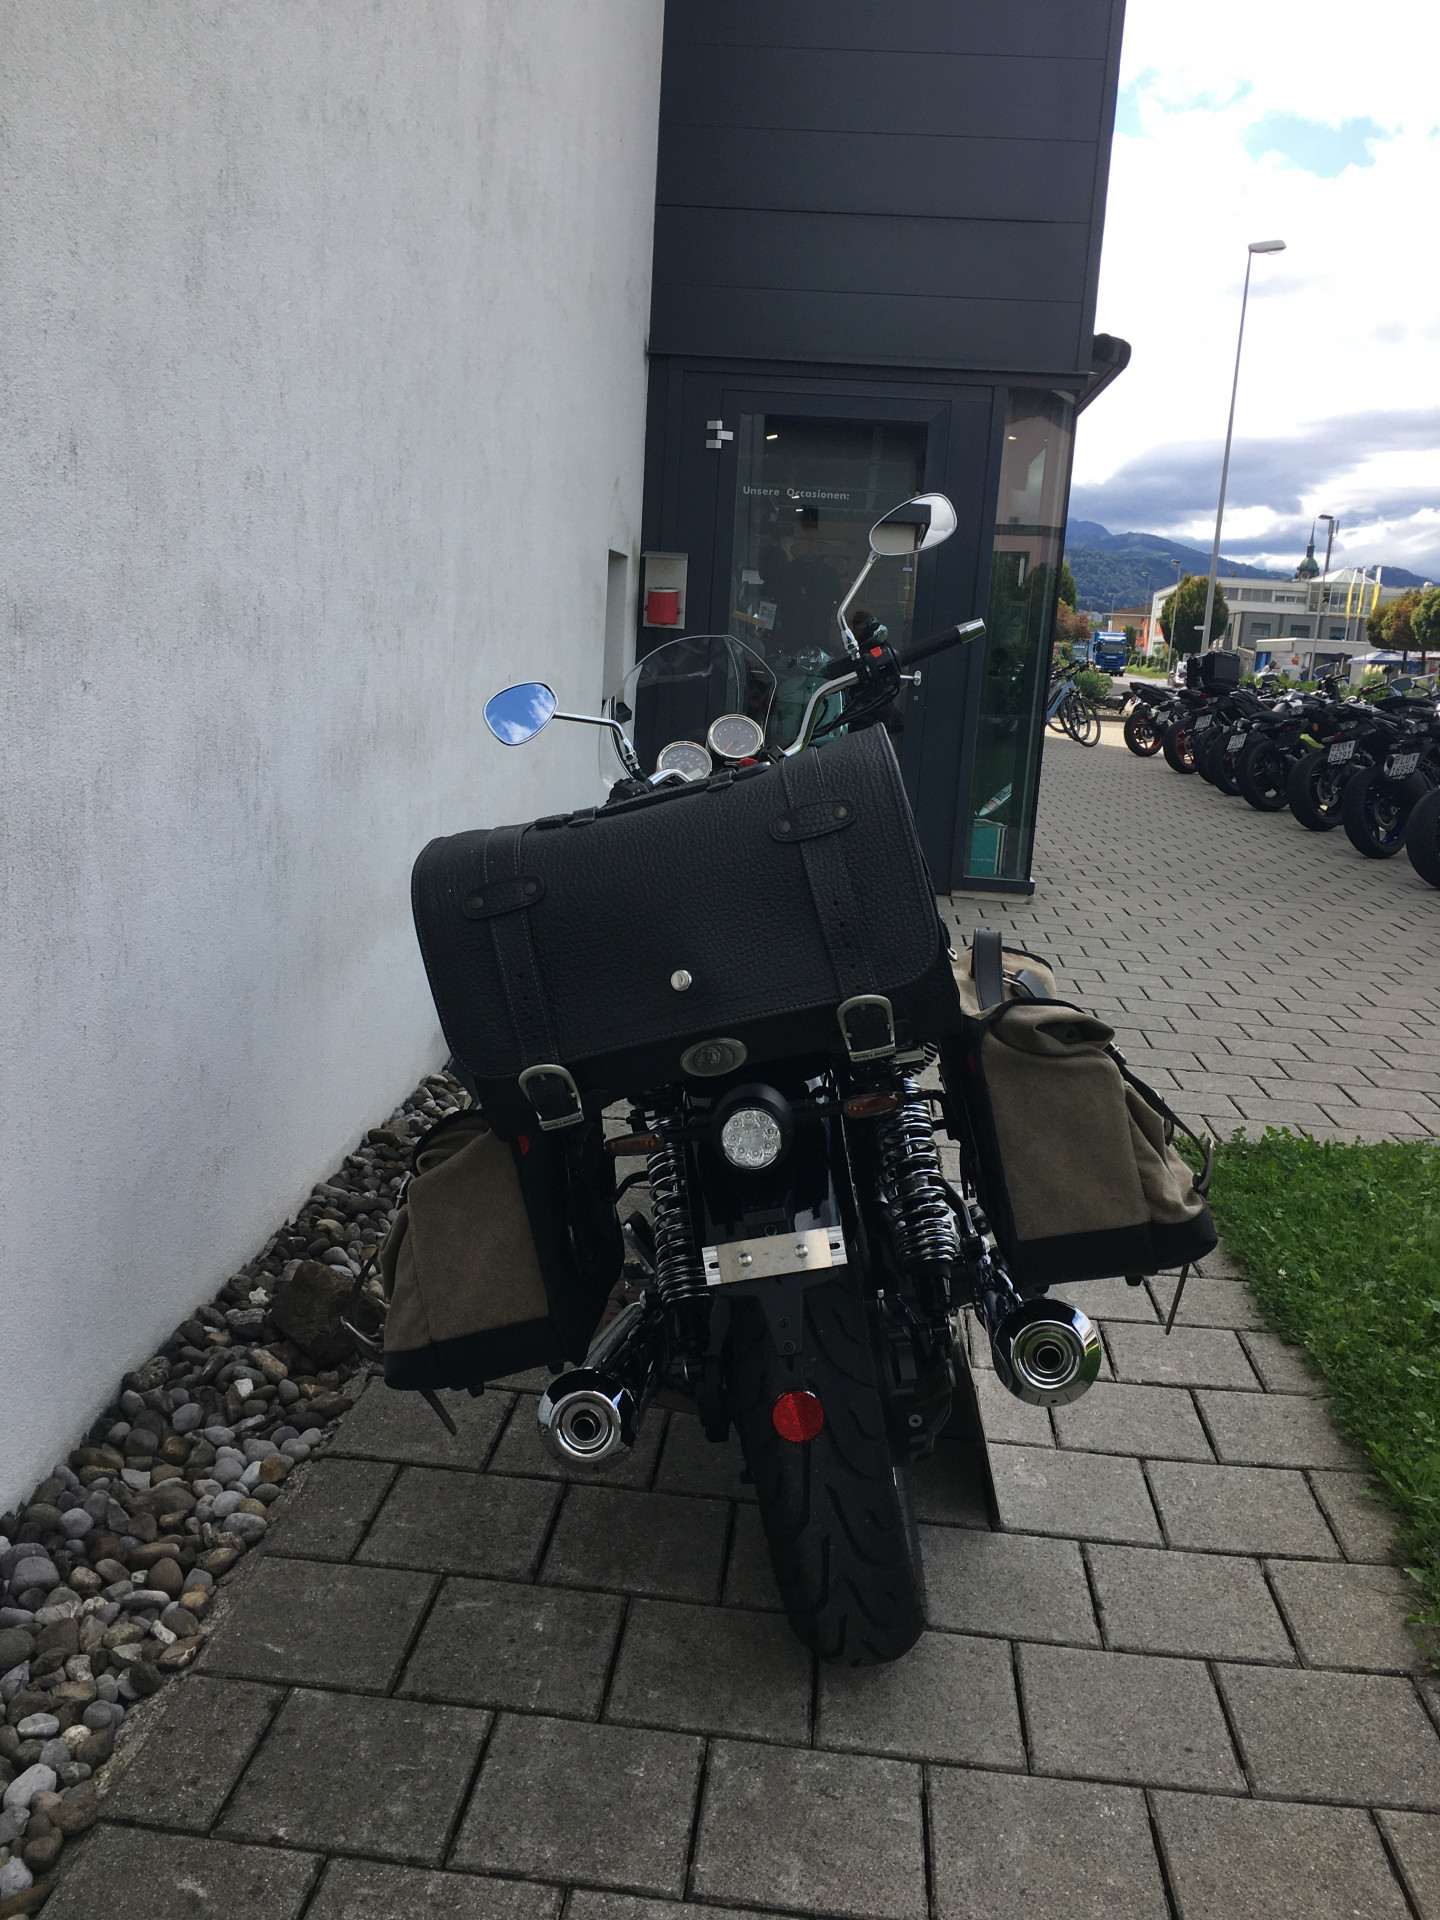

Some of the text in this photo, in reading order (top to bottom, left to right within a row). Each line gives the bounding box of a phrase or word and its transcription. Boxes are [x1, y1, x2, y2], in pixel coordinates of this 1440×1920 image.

[743, 485, 850, 500] Unsere Occasionen:
[1391, 764, 1414, 776] 16956
